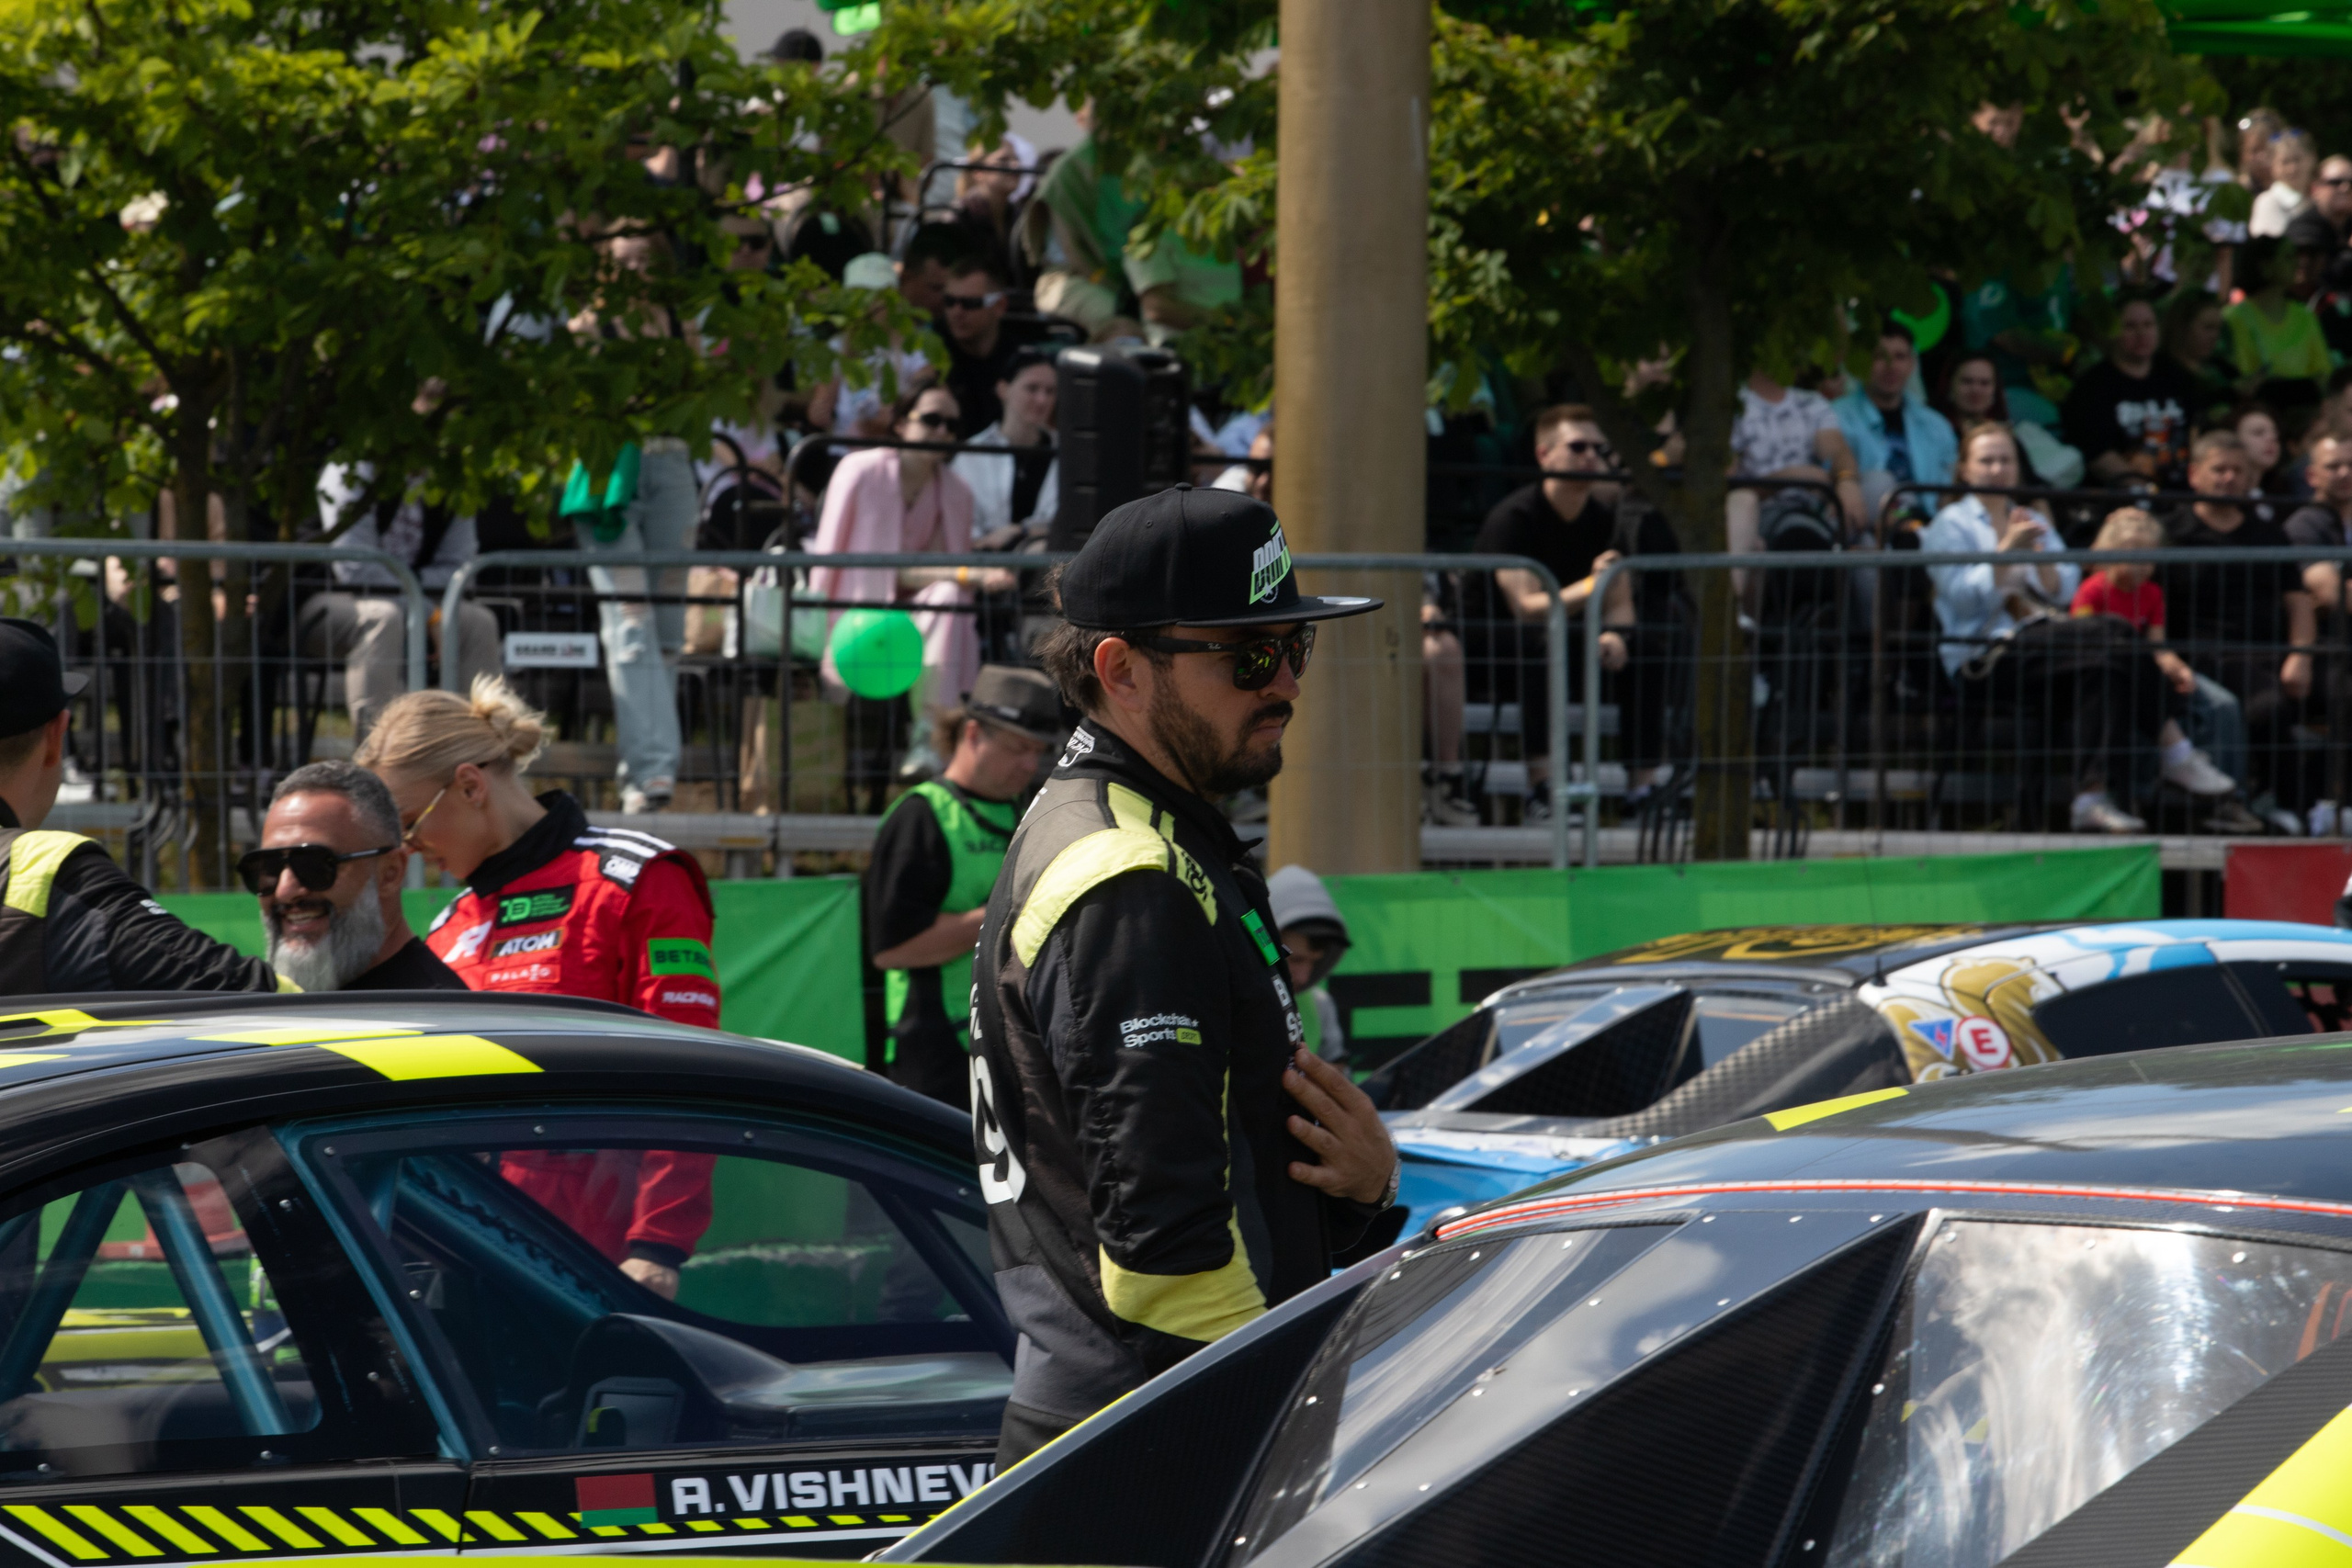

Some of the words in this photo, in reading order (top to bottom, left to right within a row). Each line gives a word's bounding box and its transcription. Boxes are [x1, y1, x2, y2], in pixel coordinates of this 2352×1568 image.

[498, 931, 558, 957] ATOM
[1124, 1028, 1177, 1047] Sports
[1970, 1029, 1998, 1055] E
[671, 1462, 996, 1515] A.VISHNEV
